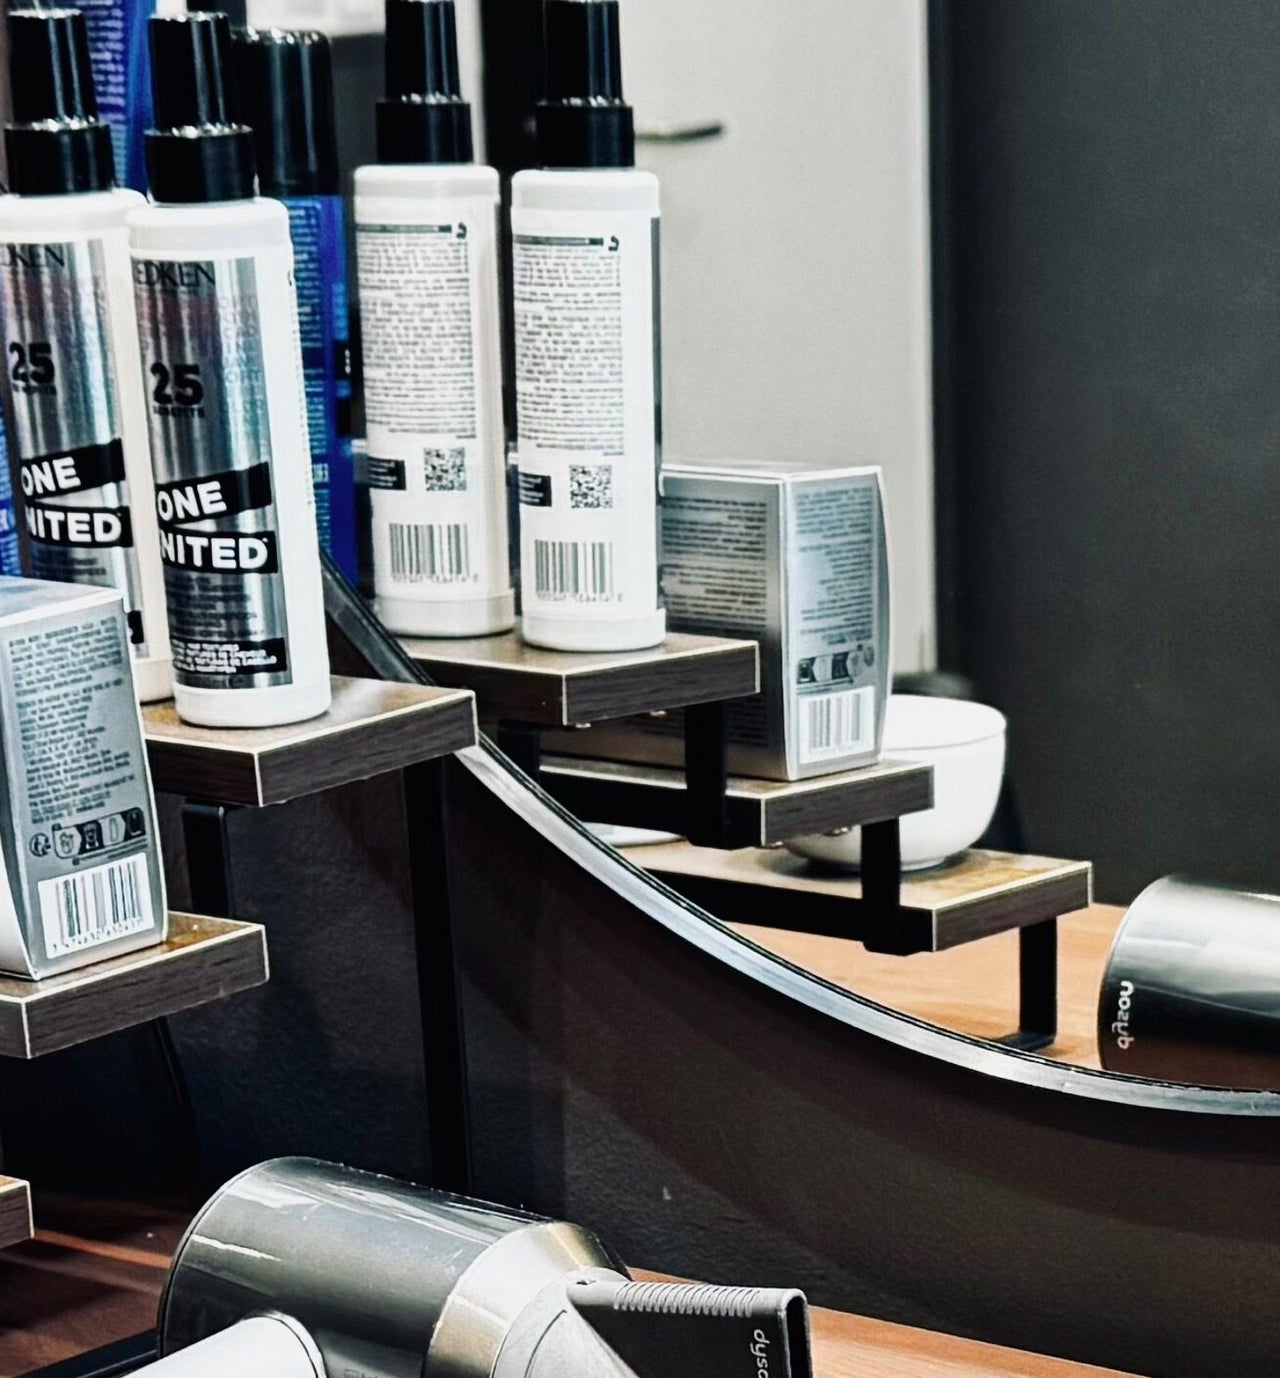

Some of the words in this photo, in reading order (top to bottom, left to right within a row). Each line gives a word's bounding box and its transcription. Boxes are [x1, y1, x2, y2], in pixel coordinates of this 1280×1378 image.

[9, 342, 55, 384] 25
[151, 362, 204, 407] 25
[21, 456, 82, 496] ONE
[157, 480, 227, 522] ONE
